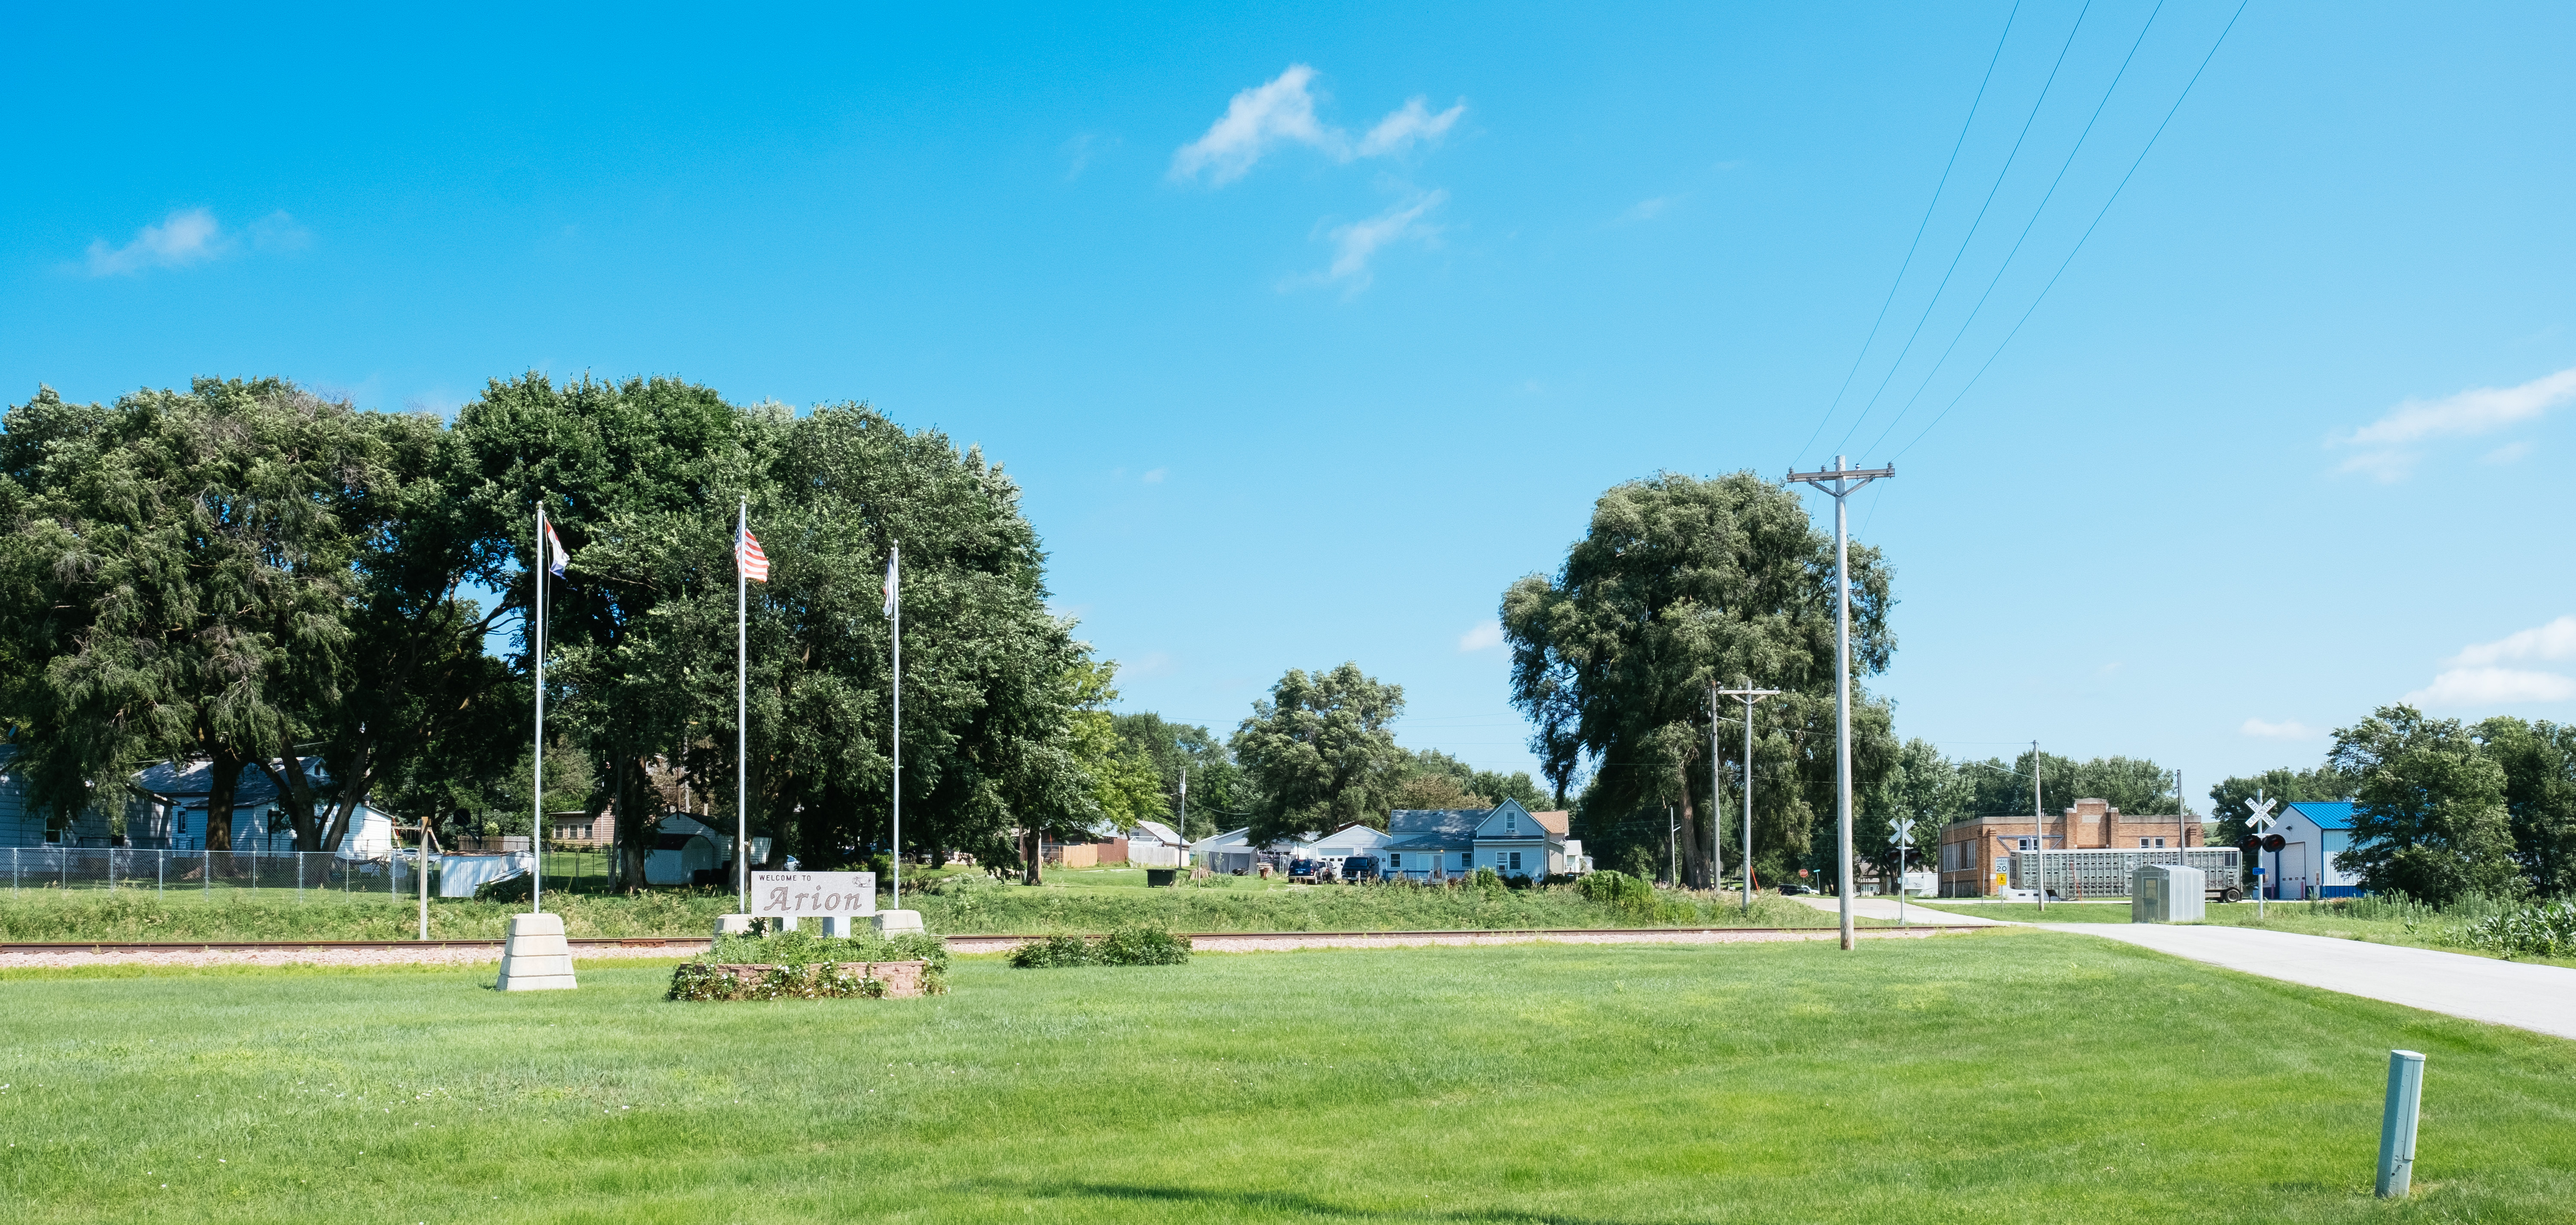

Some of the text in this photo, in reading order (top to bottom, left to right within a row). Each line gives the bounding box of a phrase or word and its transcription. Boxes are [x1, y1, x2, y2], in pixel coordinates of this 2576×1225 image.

[2246, 799, 2275, 826] RAIL ROAD
[2248, 800, 2274, 824] CROSSING
[763, 885, 862, 911] Arion
